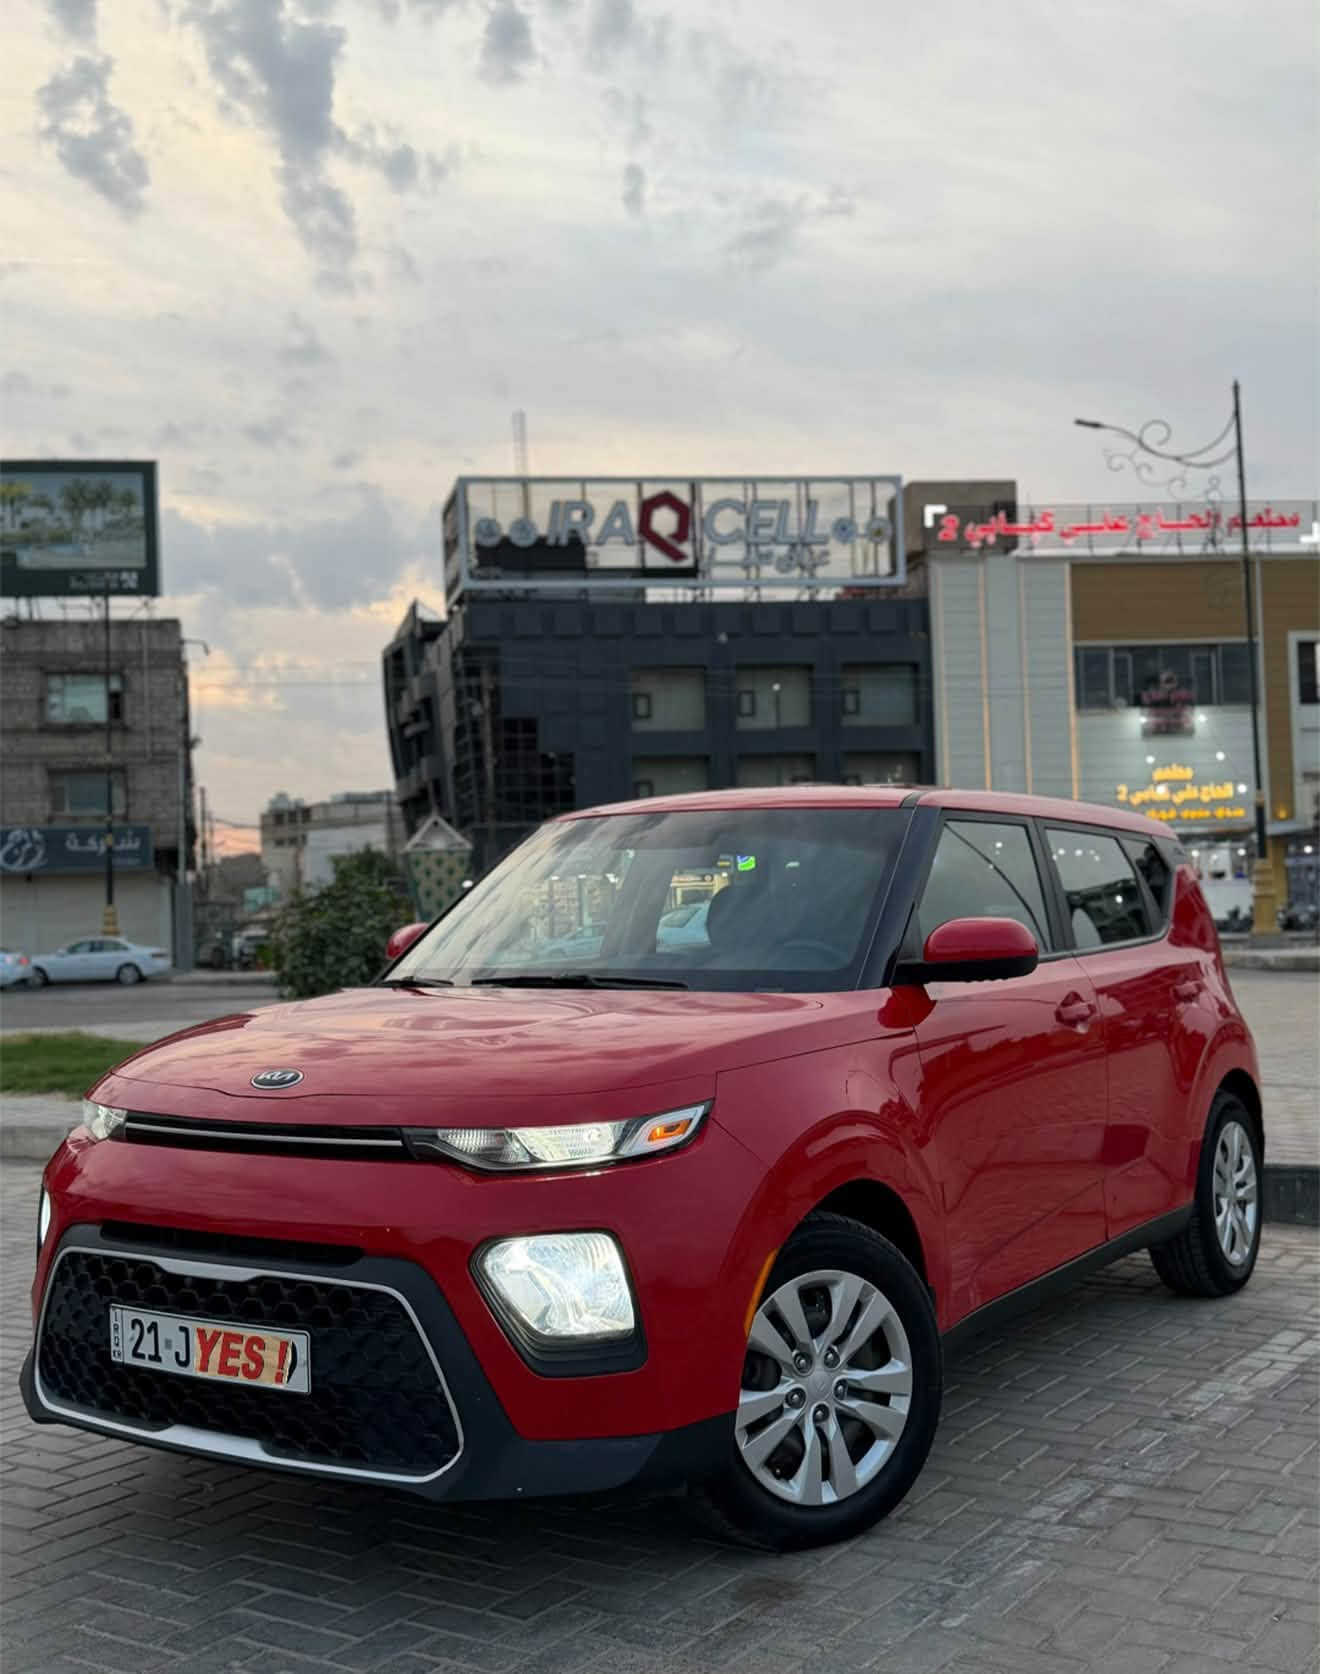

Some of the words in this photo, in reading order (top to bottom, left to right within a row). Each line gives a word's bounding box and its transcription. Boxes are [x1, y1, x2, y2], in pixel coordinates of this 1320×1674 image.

[938, 514, 960, 541] 2
[130, 1317, 162, 1363] 21
[174, 1326, 191, 1368] J
